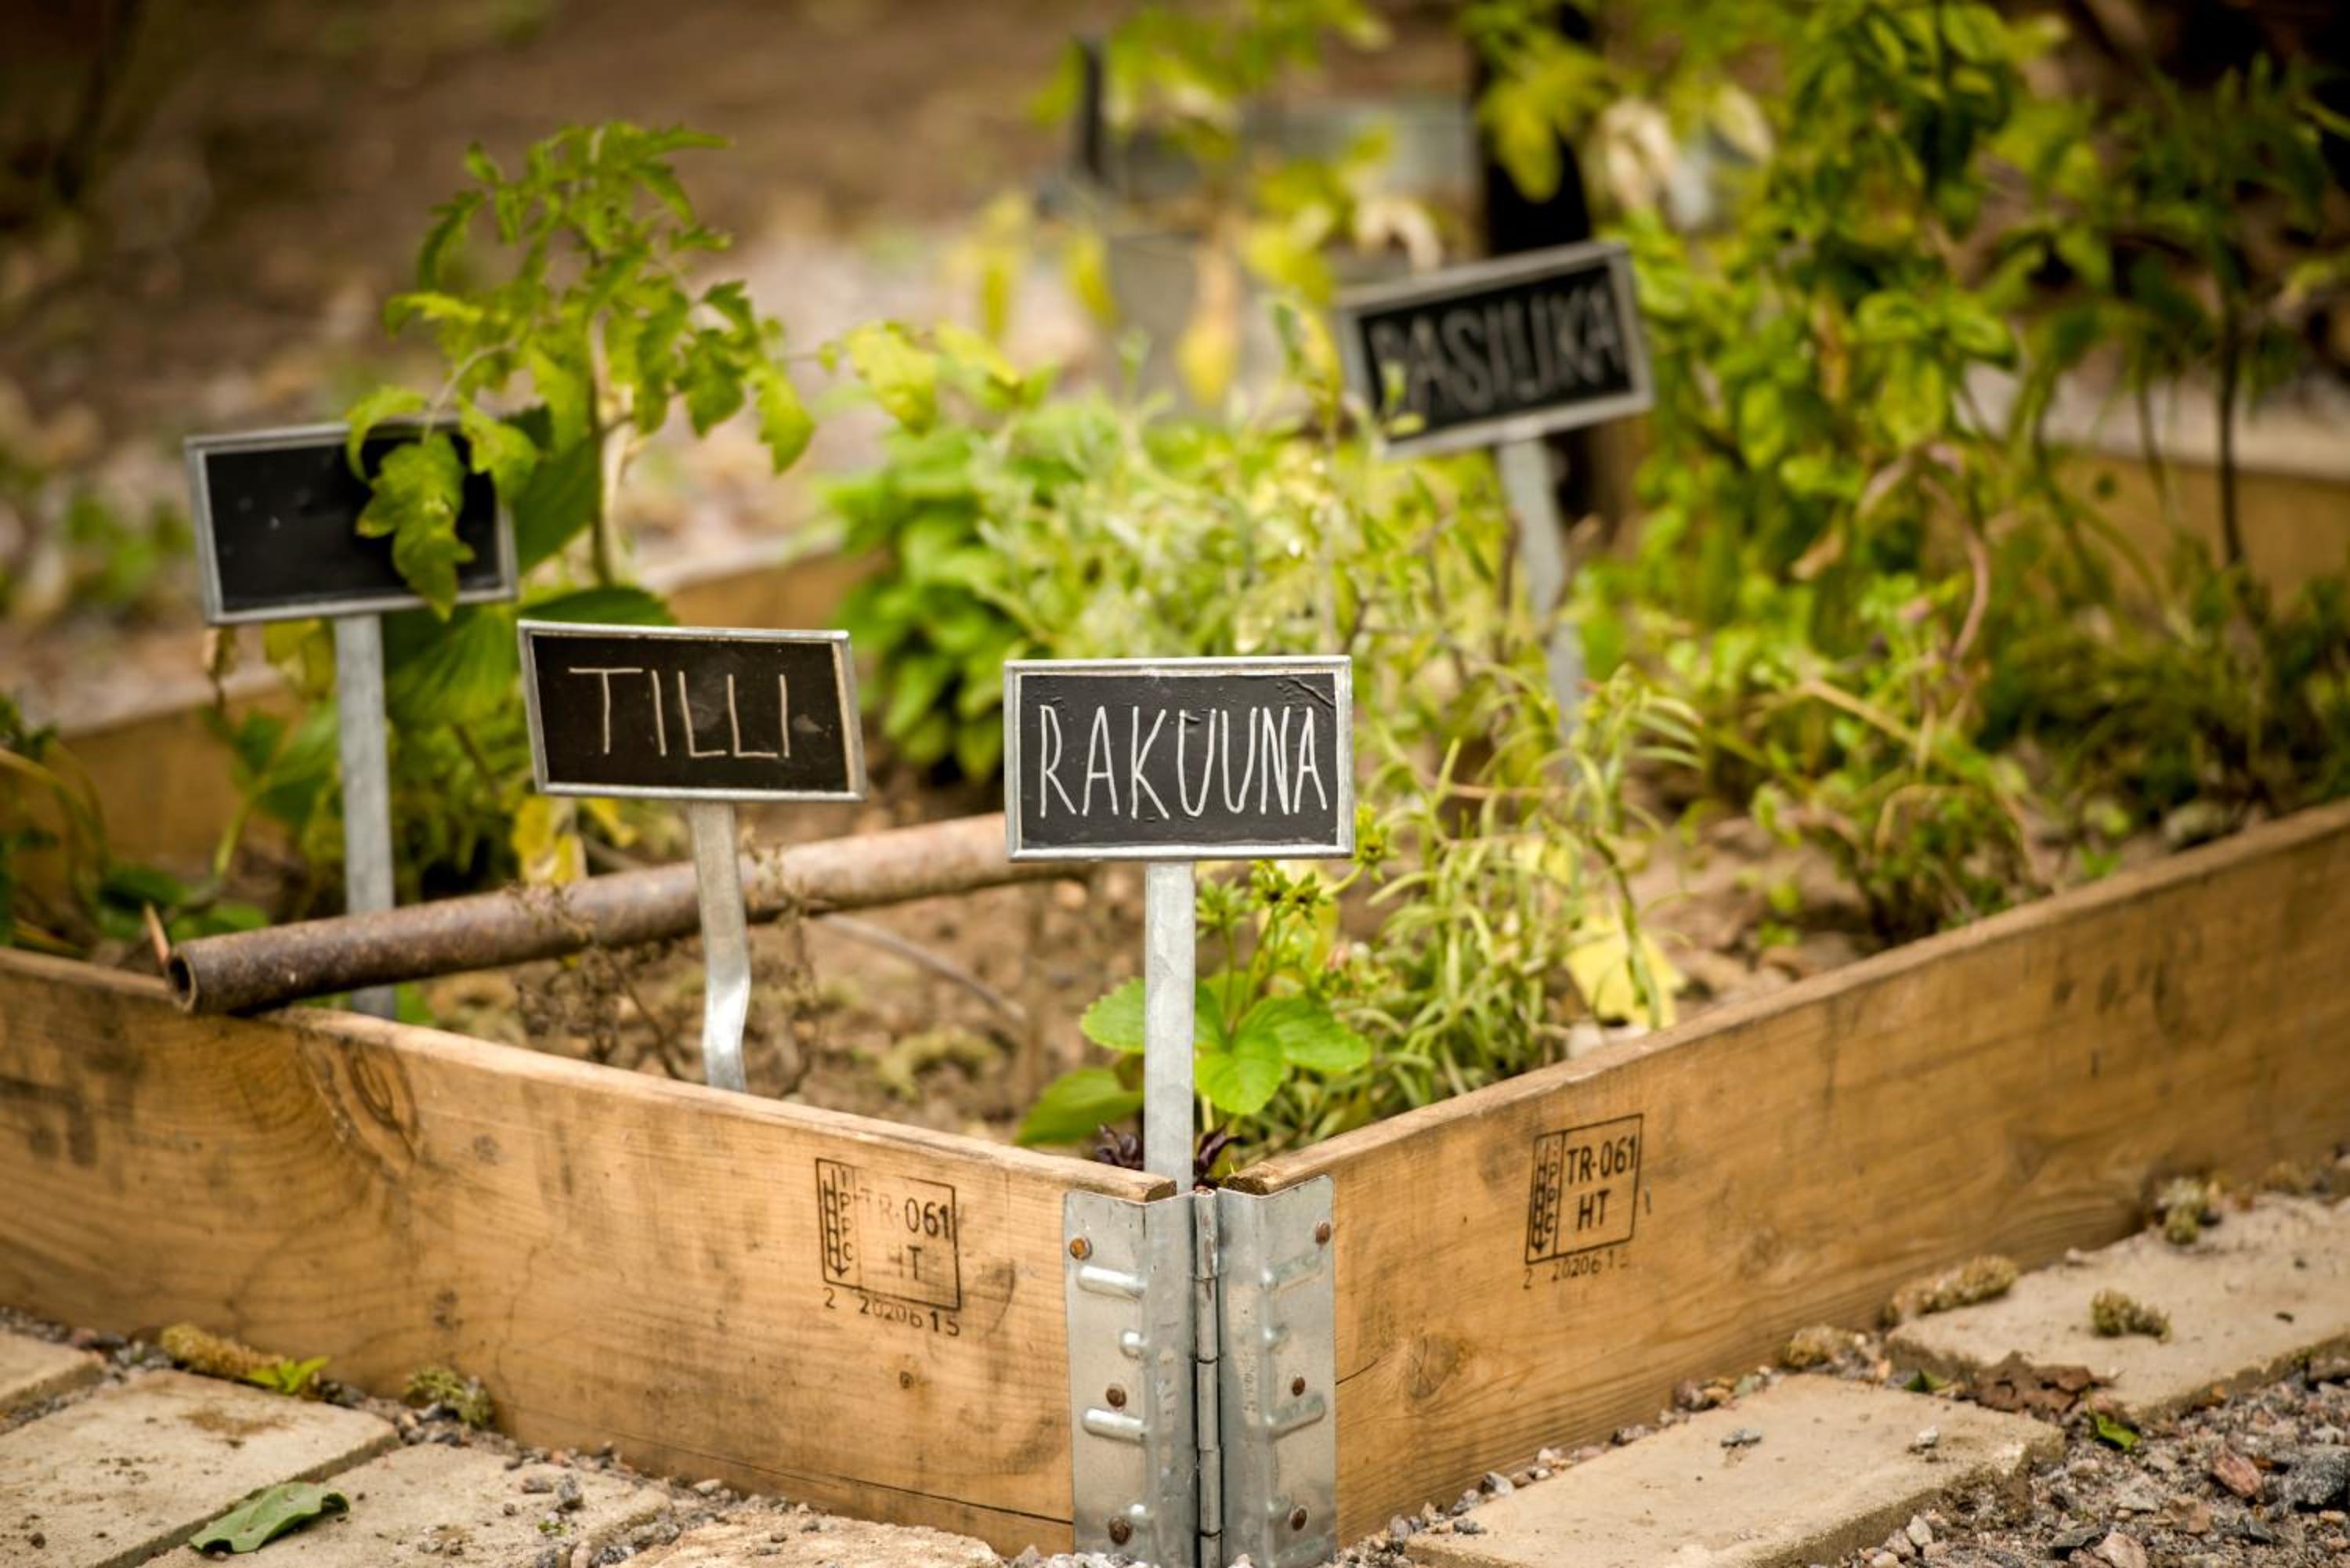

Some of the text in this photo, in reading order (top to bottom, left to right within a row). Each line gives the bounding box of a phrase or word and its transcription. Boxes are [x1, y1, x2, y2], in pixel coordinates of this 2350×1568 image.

[569, 667, 790, 758] TILLI
[1040, 704, 1329, 819] RAKUUNA
[1567, 1135, 1636, 1185] TR-061
[1577, 1188, 1611, 1230] HT
[823, 1287, 836, 1310] 2
